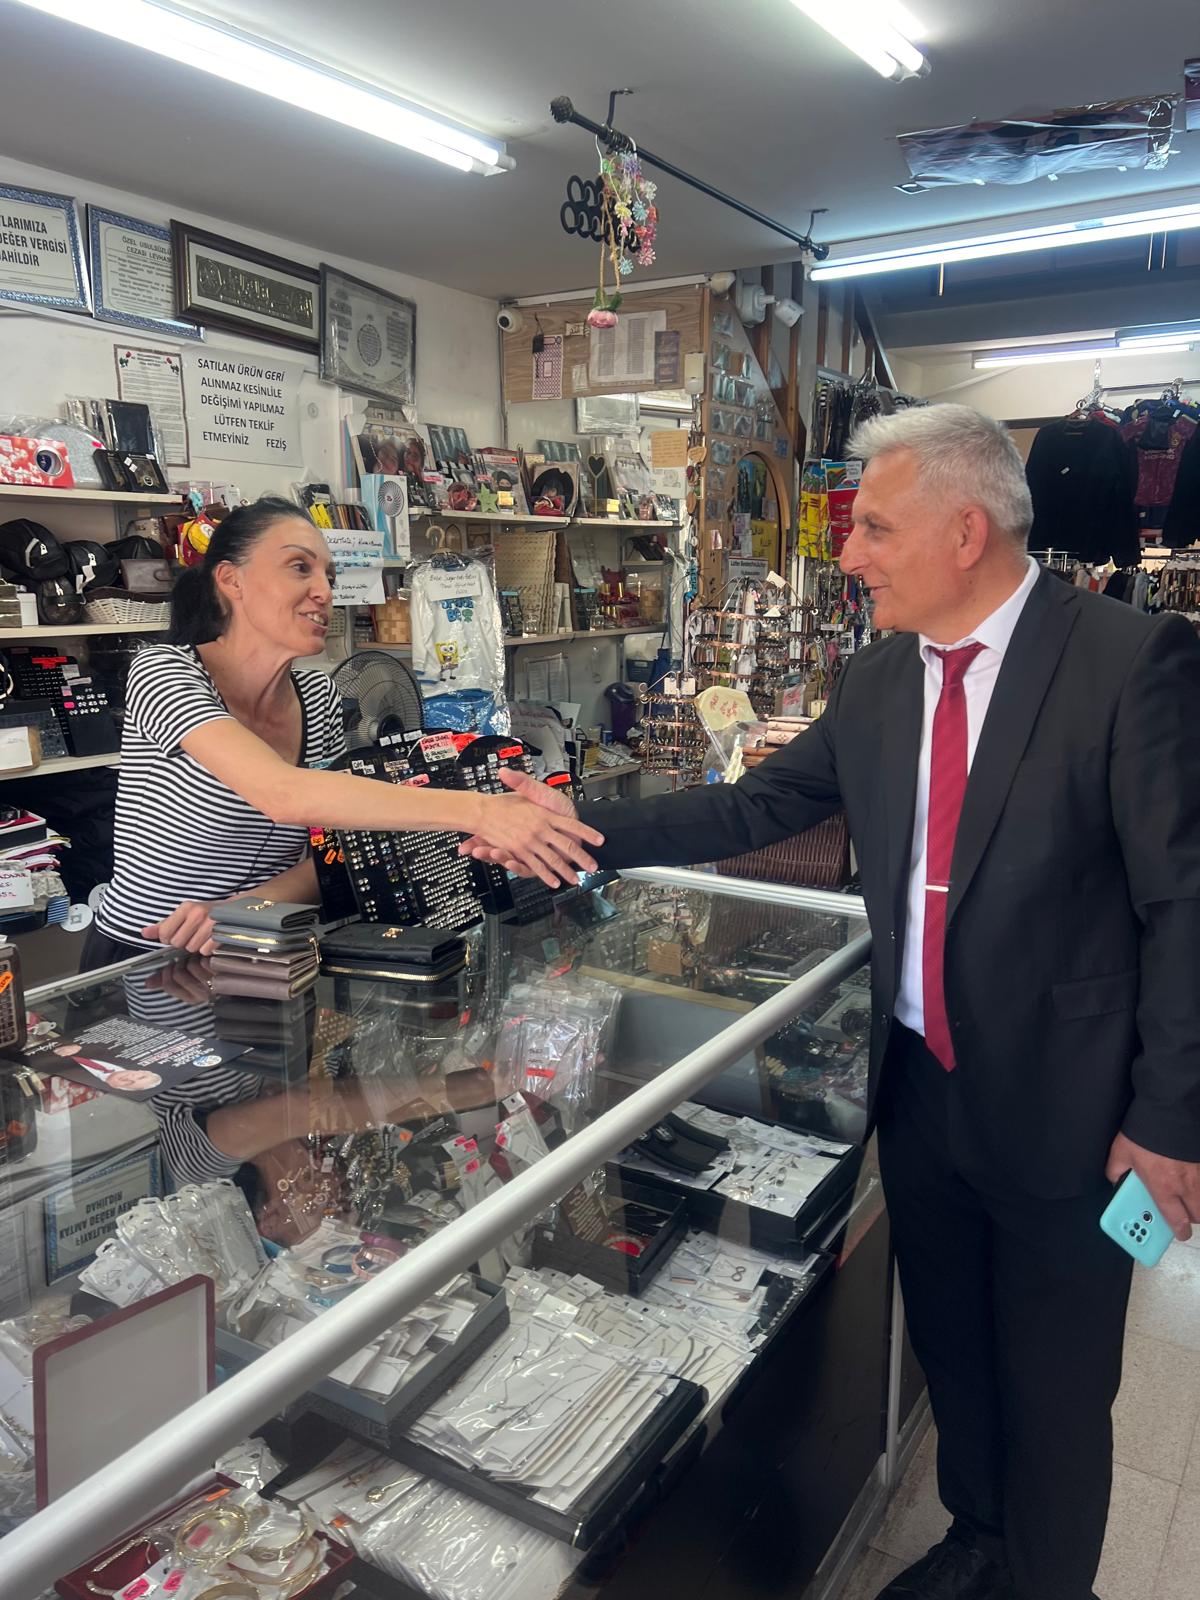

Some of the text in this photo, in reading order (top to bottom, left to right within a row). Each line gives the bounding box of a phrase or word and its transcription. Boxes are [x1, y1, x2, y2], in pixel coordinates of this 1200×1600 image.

[0, 215, 48, 234] LARIMIZA
[30, 236, 68, 255] VERGİSİ
[122, 235, 172, 255] ÖZEL USULSÜZLÜ
[126, 245, 172, 263] CEZASI LEVHAS
[0, 249, 40, 267] AHİLDİR
[198, 358, 286, 382] SATILAN ÜRÜN GERİ
[201, 377, 282, 399] ALINMAZ KESİNLİLE
[201, 394, 285, 415] DEĞİŞİMİ YAPILMAZ
[214, 413, 275, 432] LÜTFEN TEKLİF
[203, 431, 287, 452] ETMEYİNİZ FEZİŞ
